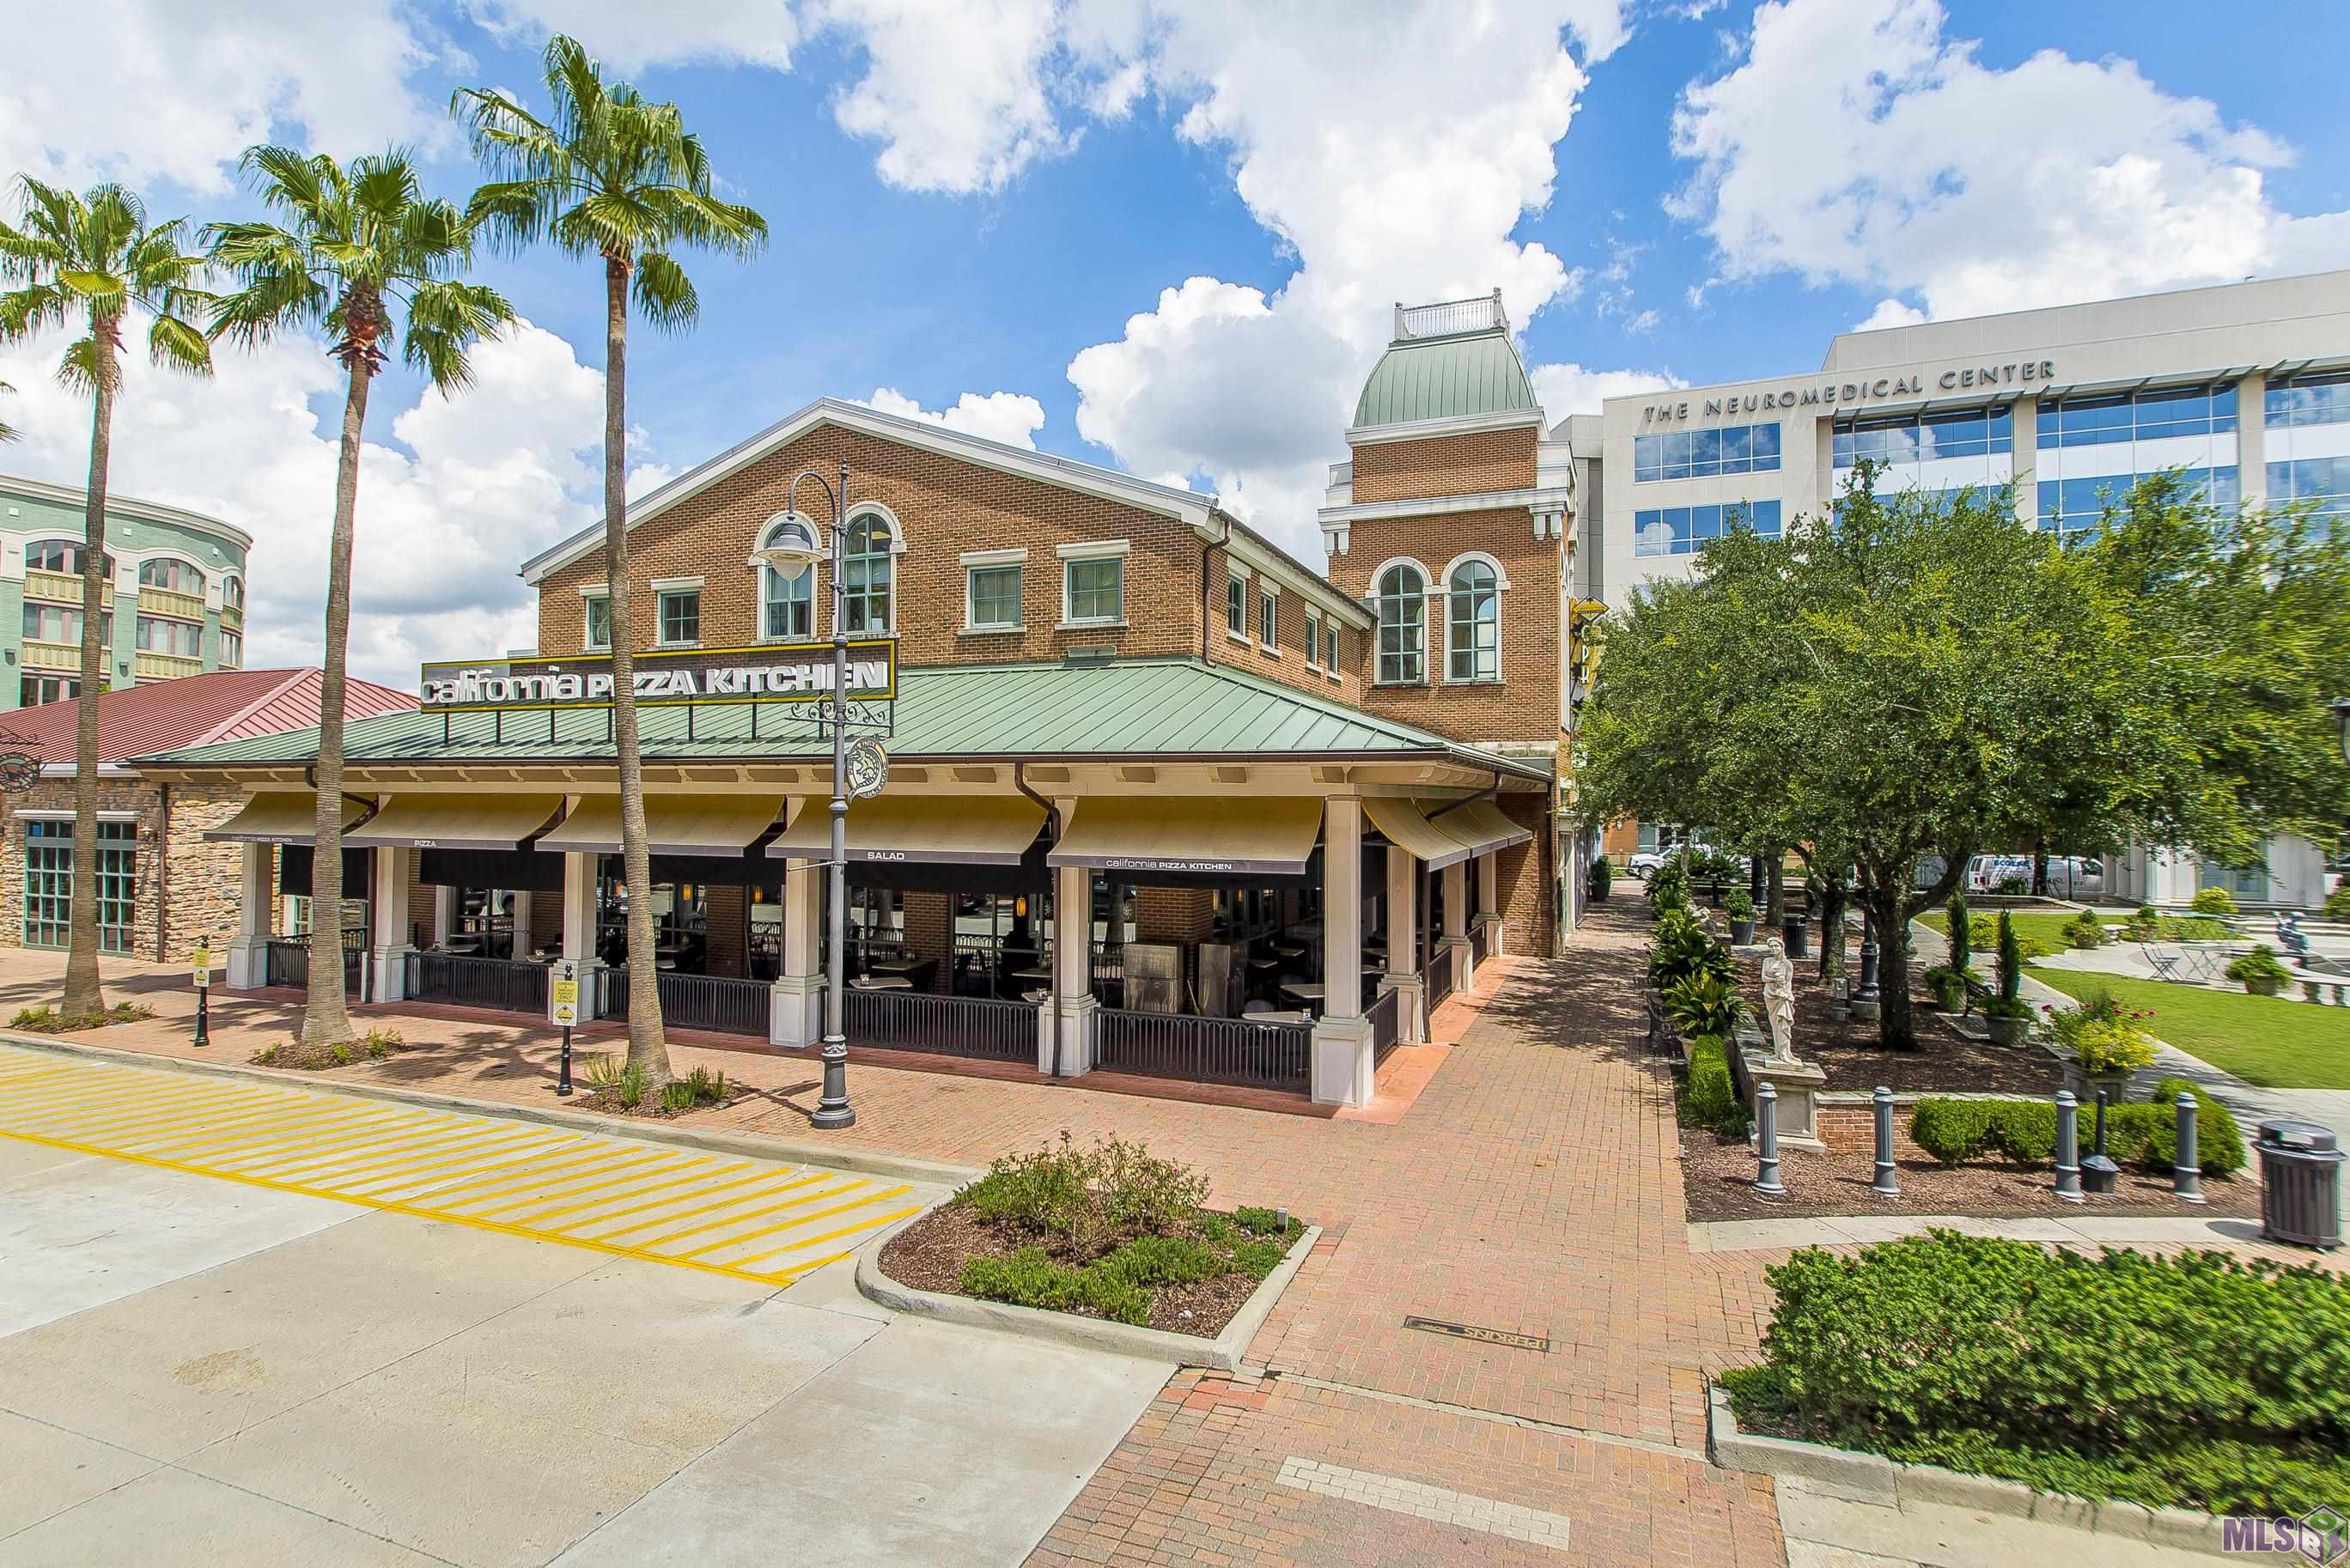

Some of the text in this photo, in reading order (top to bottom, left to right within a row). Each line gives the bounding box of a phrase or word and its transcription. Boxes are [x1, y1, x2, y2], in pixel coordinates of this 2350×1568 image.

[1645, 360, 2055, 422] THE NEUROMEDICAL CENTER
[420, 665, 582, 705] california
[705, 661, 889, 695] KITCHEN
[414, 839, 437, 848] PIZZA
[868, 852, 905, 860] SALAD
[1105, 858, 1157, 867] california
[1463, 1328, 1540, 1348] PERKINS
